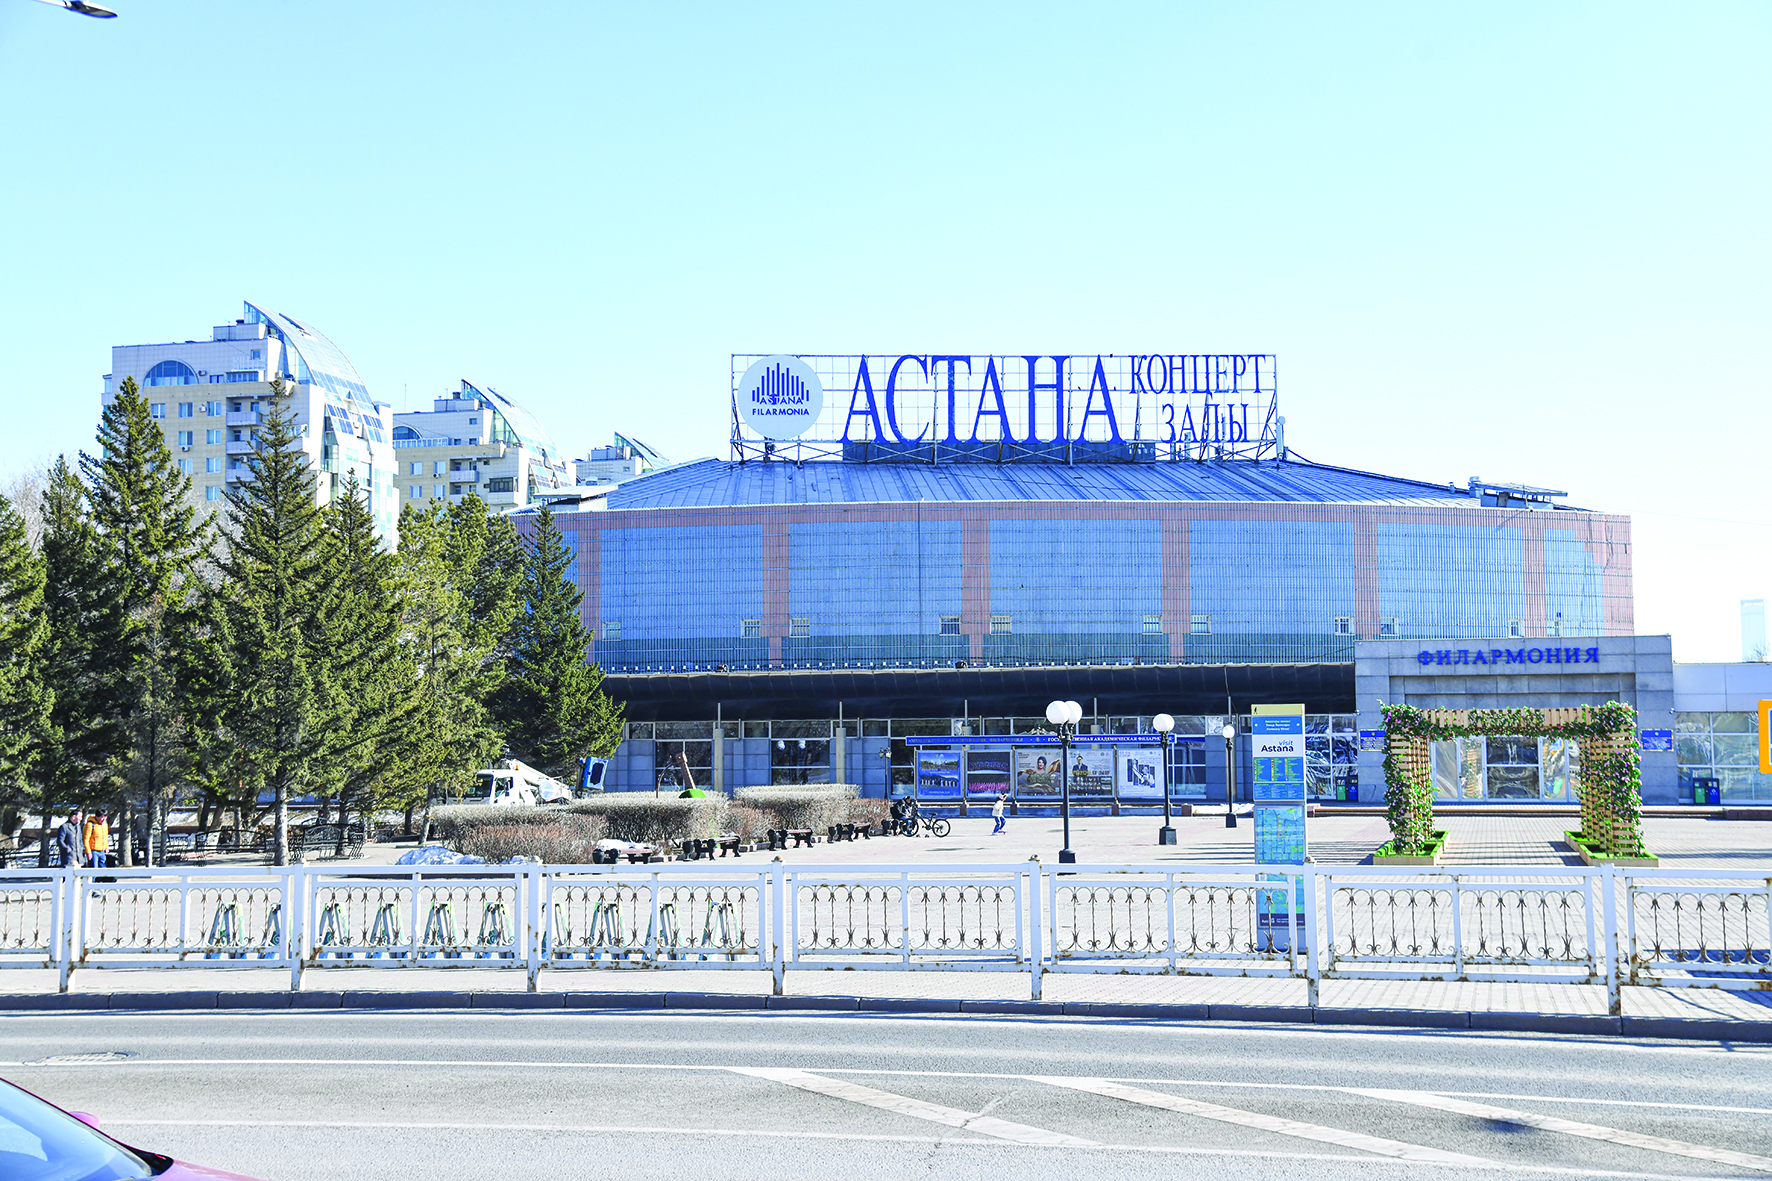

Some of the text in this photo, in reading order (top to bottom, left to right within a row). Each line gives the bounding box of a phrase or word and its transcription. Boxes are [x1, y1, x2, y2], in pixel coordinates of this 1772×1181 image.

[1128, 354, 1266, 400] КОНЦЕРТ
[752, 408, 810, 416] FILARMONIA
[836, 354, 1127, 445] АСТАНА
[1160, 403, 1251, 443] ЗАЛЫ
[1416, 647, 1599, 666] ФИЛАРМОНИЯ
